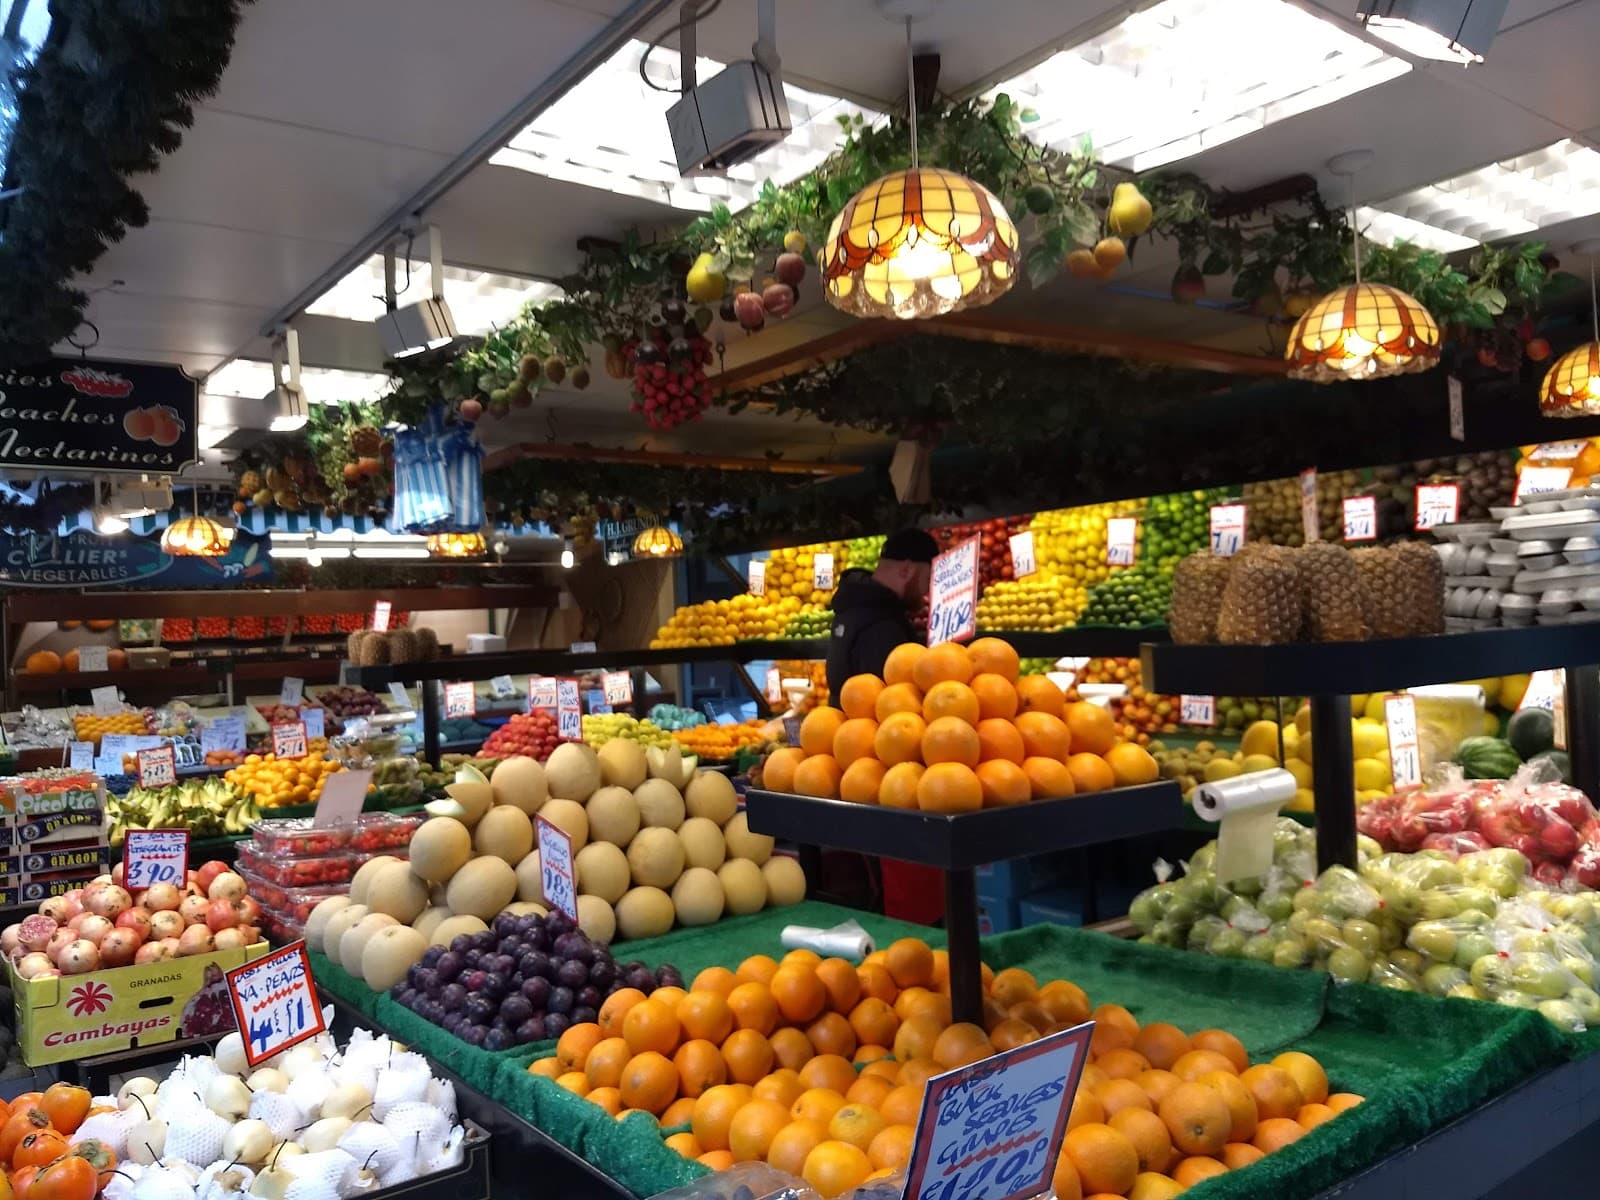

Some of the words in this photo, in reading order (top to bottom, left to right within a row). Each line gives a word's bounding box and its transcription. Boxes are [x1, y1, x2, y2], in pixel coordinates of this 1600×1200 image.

[0, 389, 115, 425] eaches
[20, 565, 129, 581] VEGETABLES
[129, 972, 183, 989] GRANADAS
[265, 961, 306, 993] PEARS
[43, 1015, 172, 1047] Cambayas
[249, 1016, 274, 1053] 4
